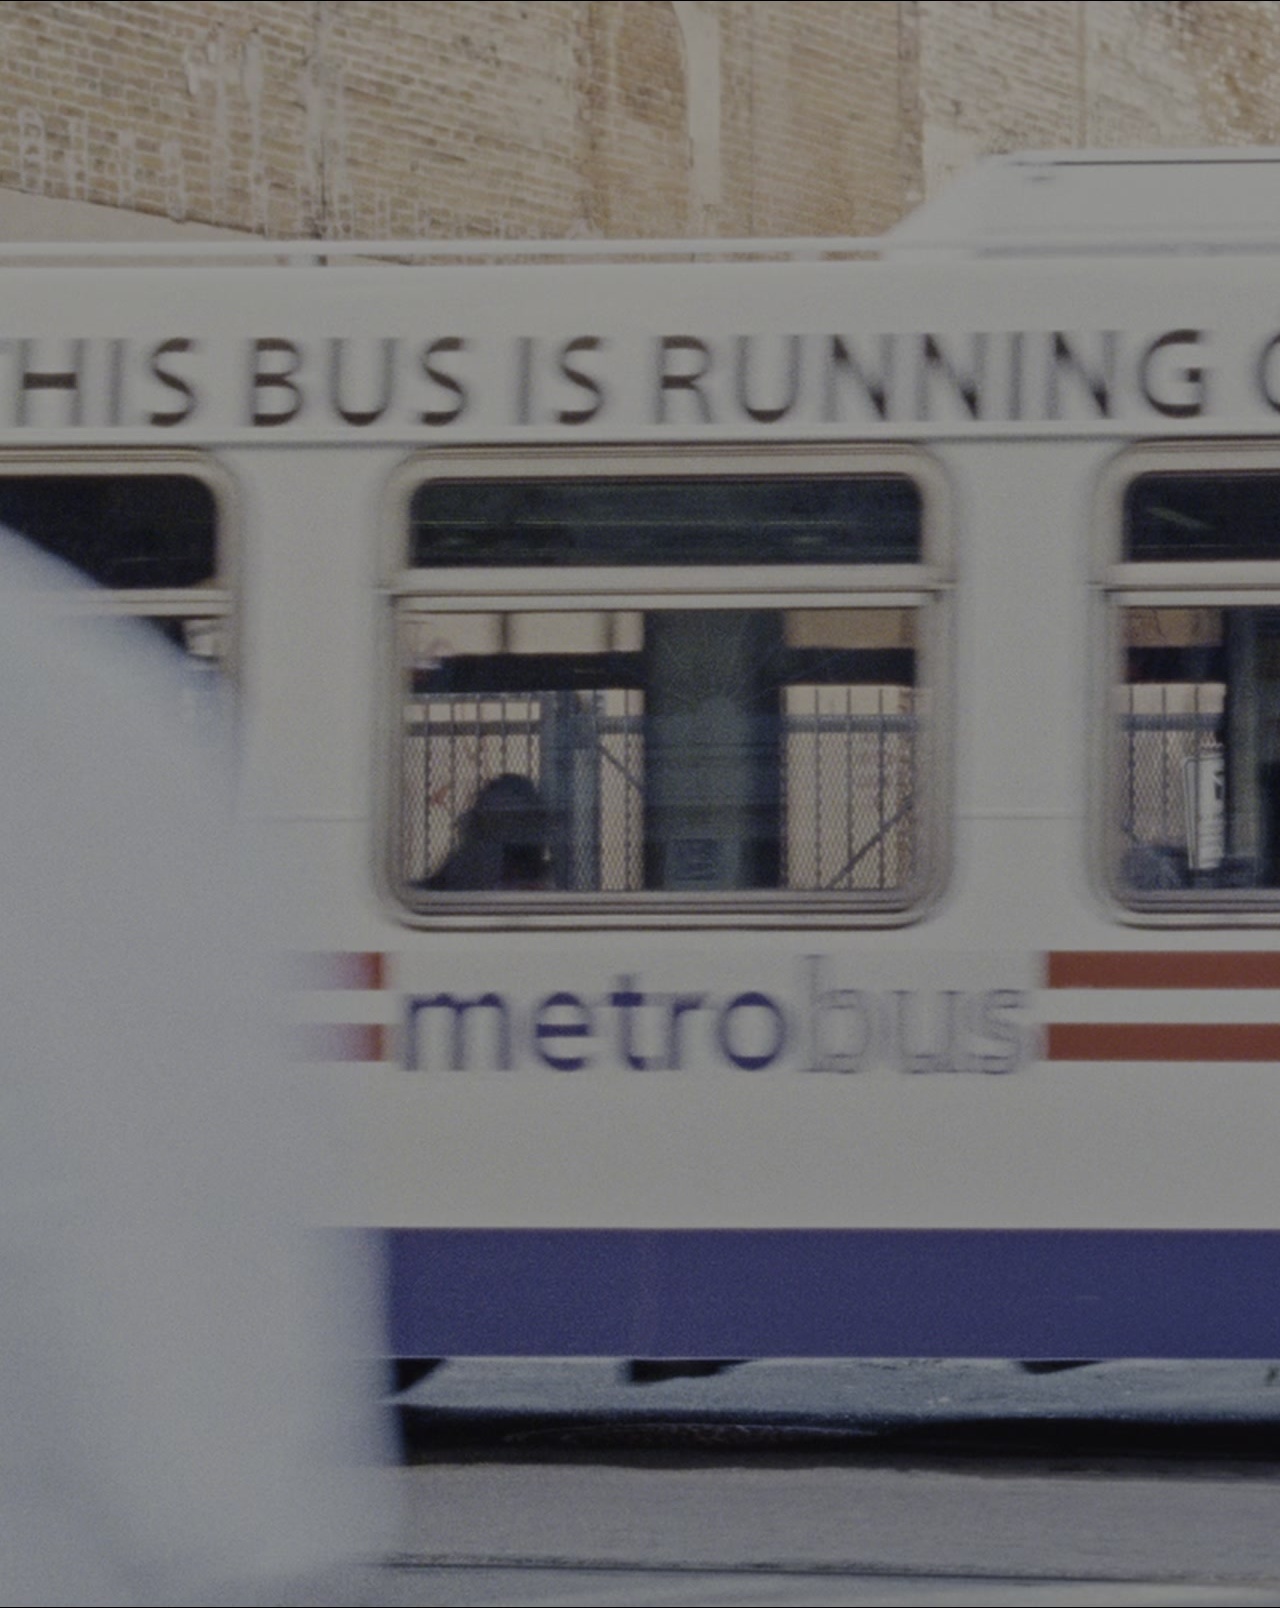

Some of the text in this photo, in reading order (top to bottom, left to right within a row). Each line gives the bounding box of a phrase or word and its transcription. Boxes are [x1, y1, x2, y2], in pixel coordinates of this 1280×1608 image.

[0, 337, 198, 426] HIS
[250, 336, 467, 426] BUS
[515, 335, 605, 425] IS
[654, 329, 1205, 424] RUNNING
